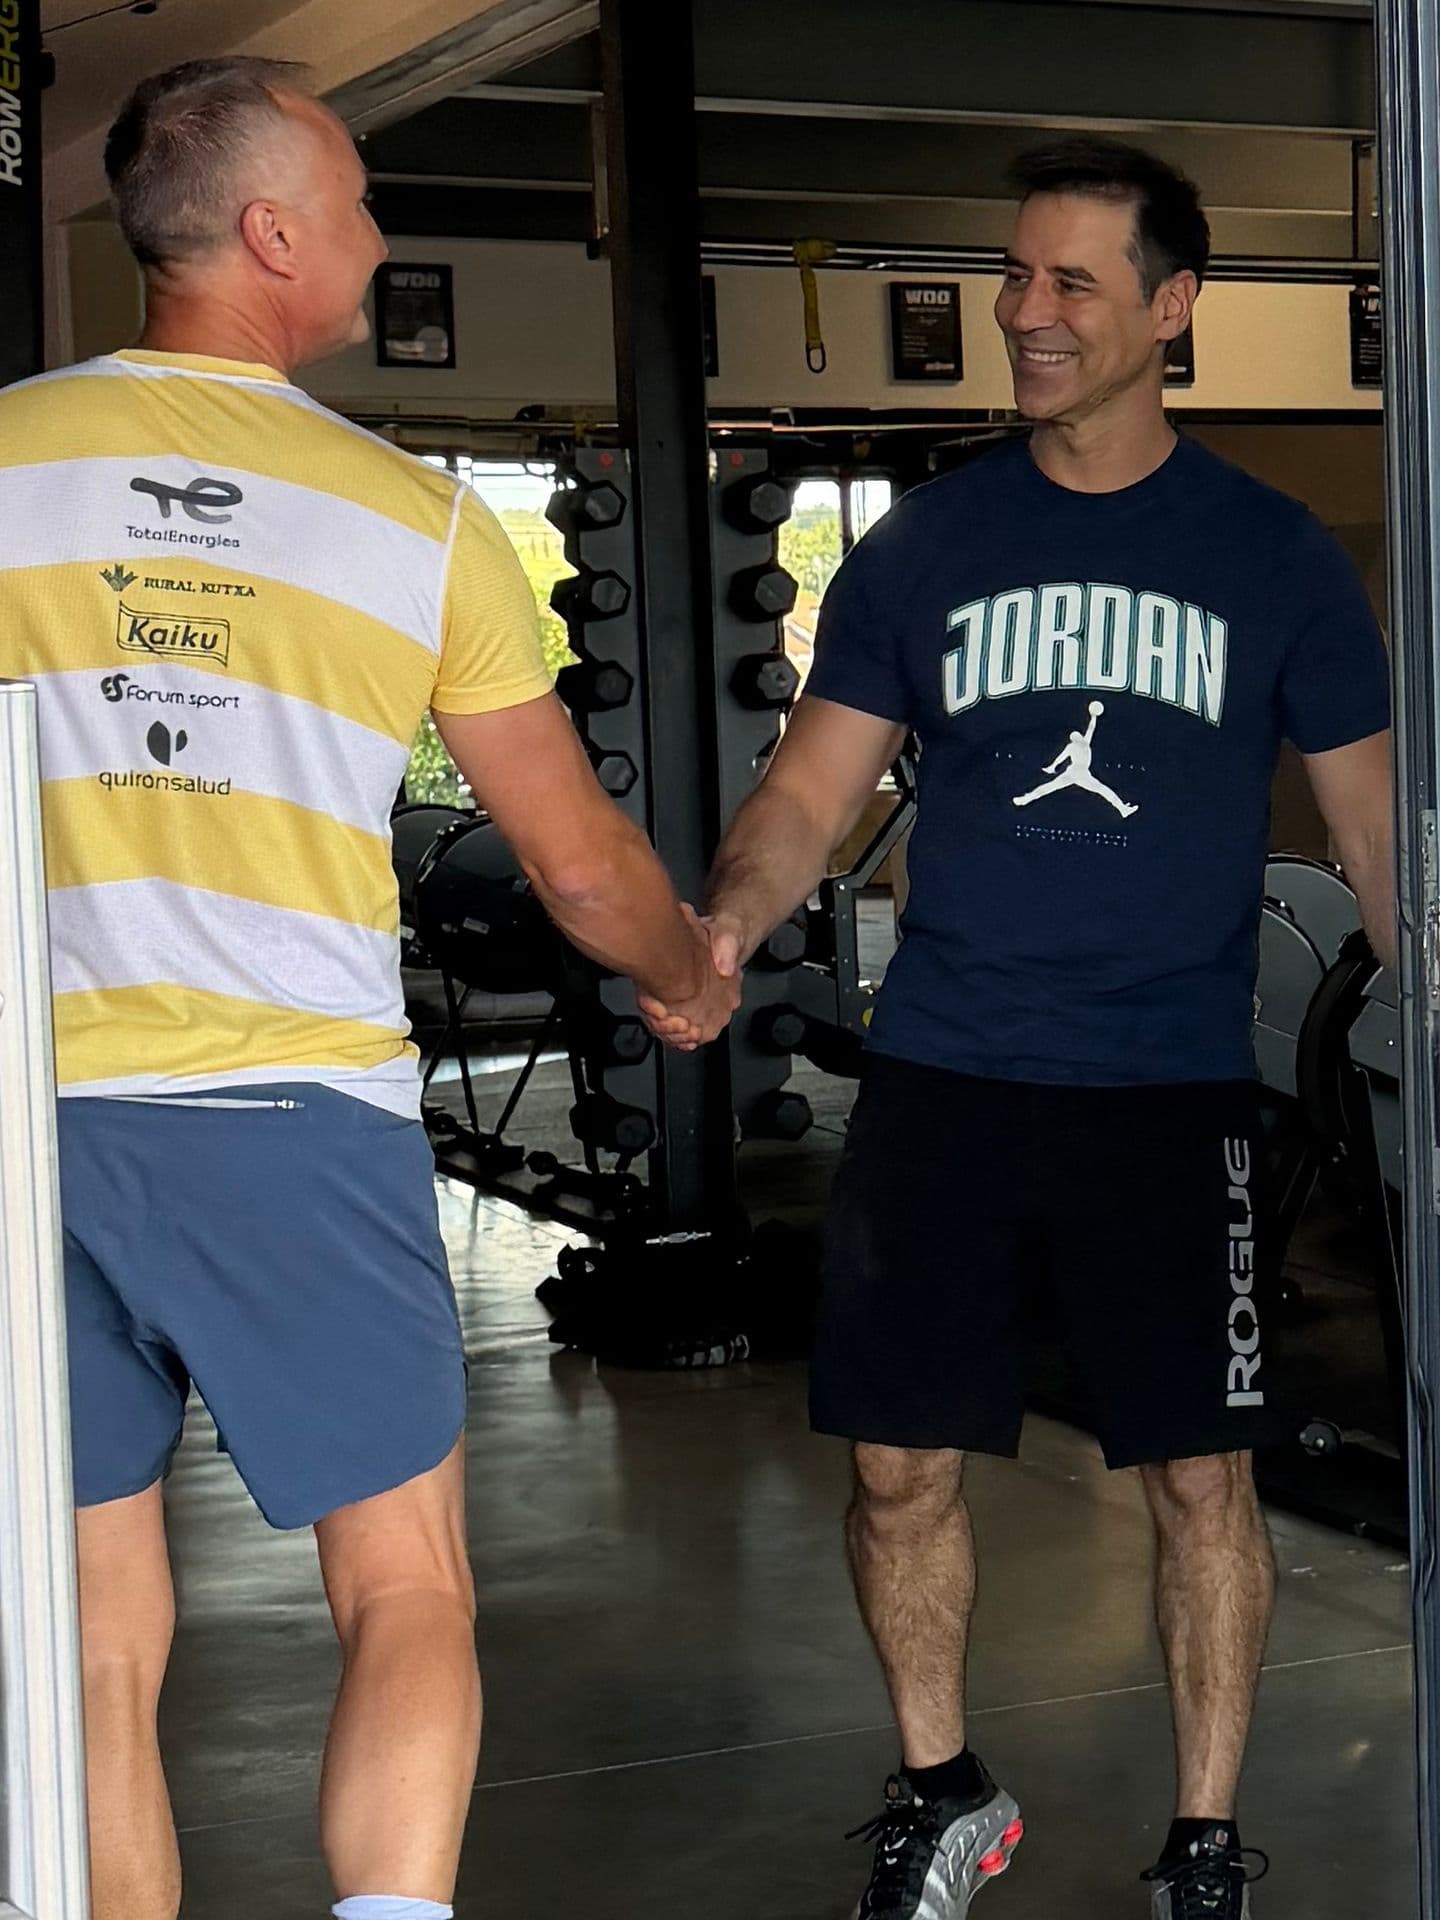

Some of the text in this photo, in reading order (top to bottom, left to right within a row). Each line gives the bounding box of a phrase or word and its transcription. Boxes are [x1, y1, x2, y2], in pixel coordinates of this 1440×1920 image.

[126, 525, 240, 549] TotalEnergies
[144, 577, 257, 598] RURAL KUTXA
[128, 616, 219, 655] Kaiku
[942, 582, 1228, 728] JORDAN
[189, 693, 241, 709] sport
[1224, 1137, 1264, 1407] ROGUE
